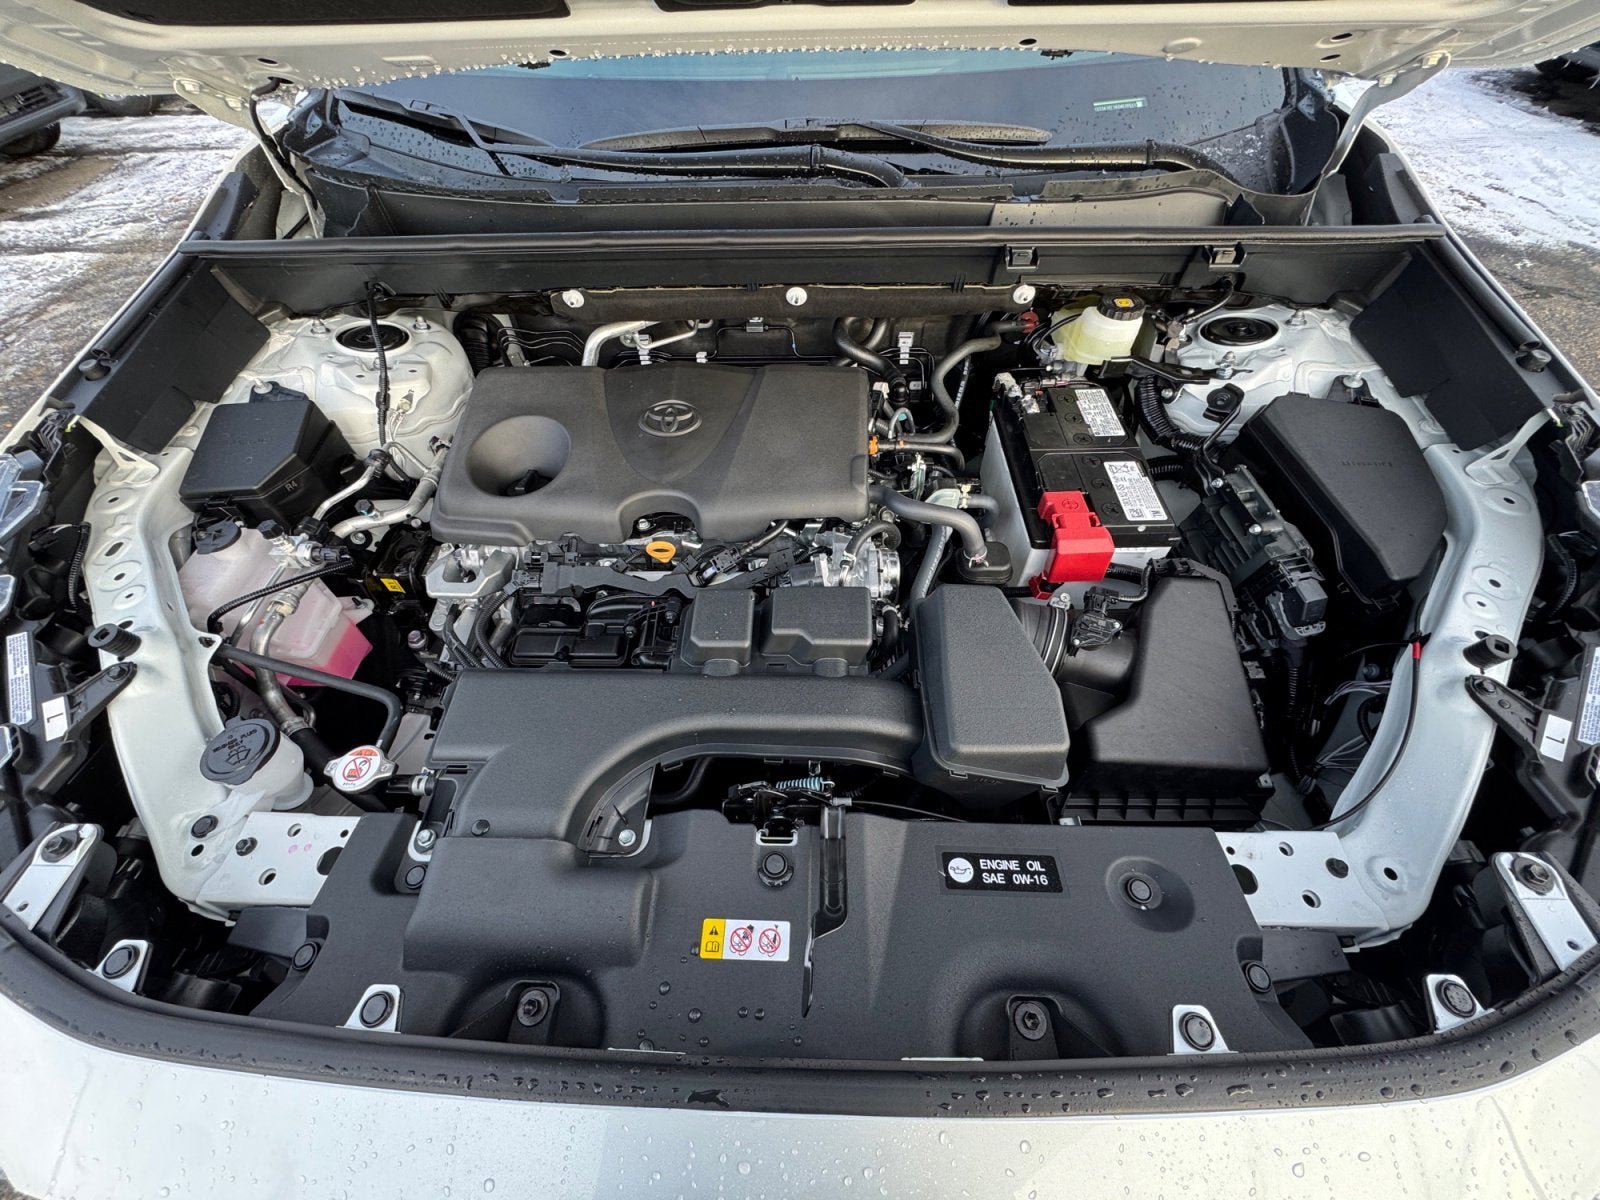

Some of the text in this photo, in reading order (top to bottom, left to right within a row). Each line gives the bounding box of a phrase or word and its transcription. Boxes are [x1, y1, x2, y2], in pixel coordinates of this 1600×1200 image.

[284, 480, 298, 492] R4
[979, 859, 1046, 872] ENGINE OIL
[982, 873, 1049, 886] SAE 0W-16
